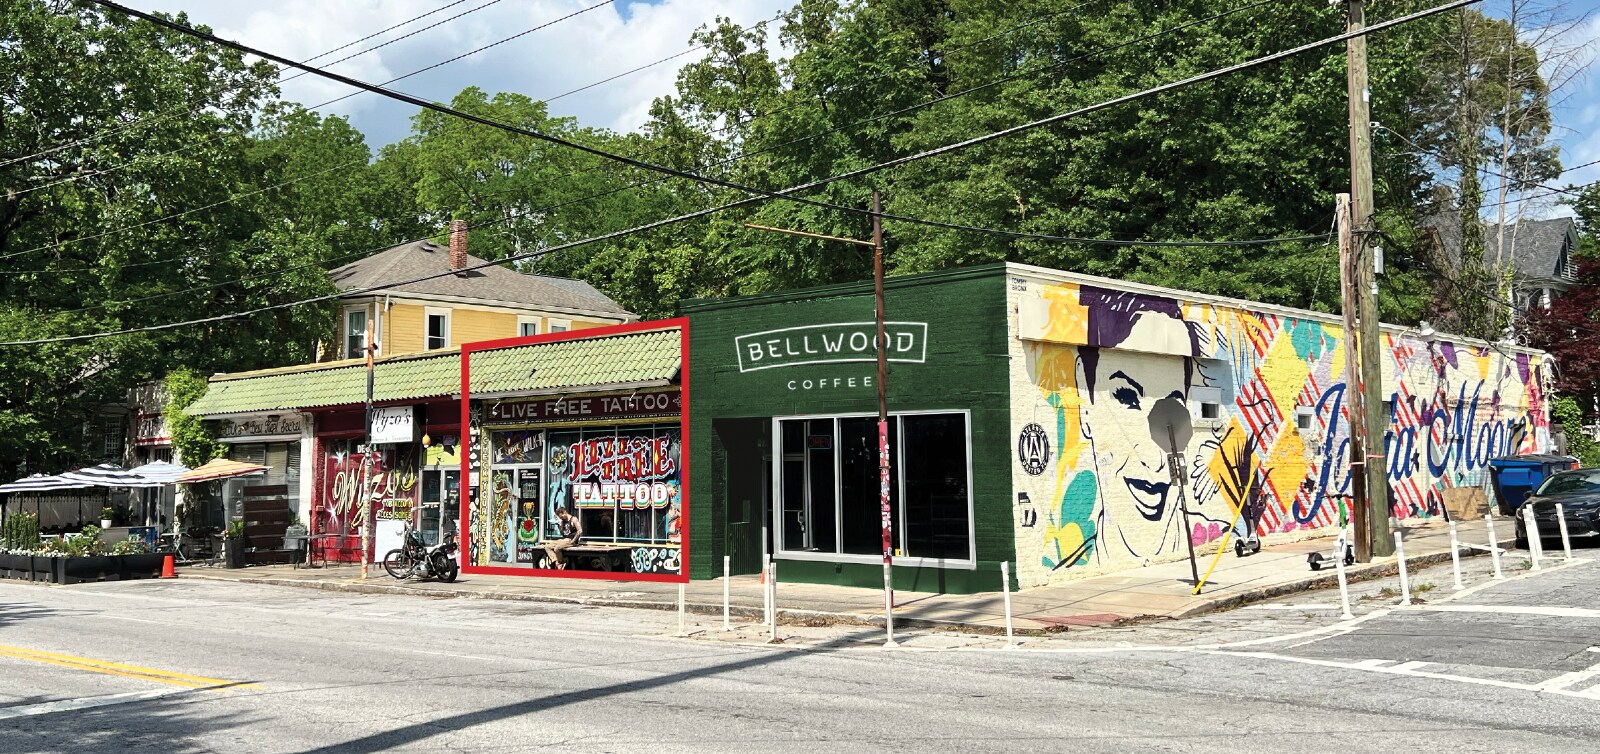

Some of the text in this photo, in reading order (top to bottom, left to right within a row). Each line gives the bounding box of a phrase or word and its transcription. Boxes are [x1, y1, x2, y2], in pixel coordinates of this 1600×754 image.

[747, 331, 914, 362] BELLWOOD
[787, 376, 872, 390] COFFEE
[501, 393, 669, 419] LIVE FREE TATTOO
[573, 482, 669, 510] TATTOO
